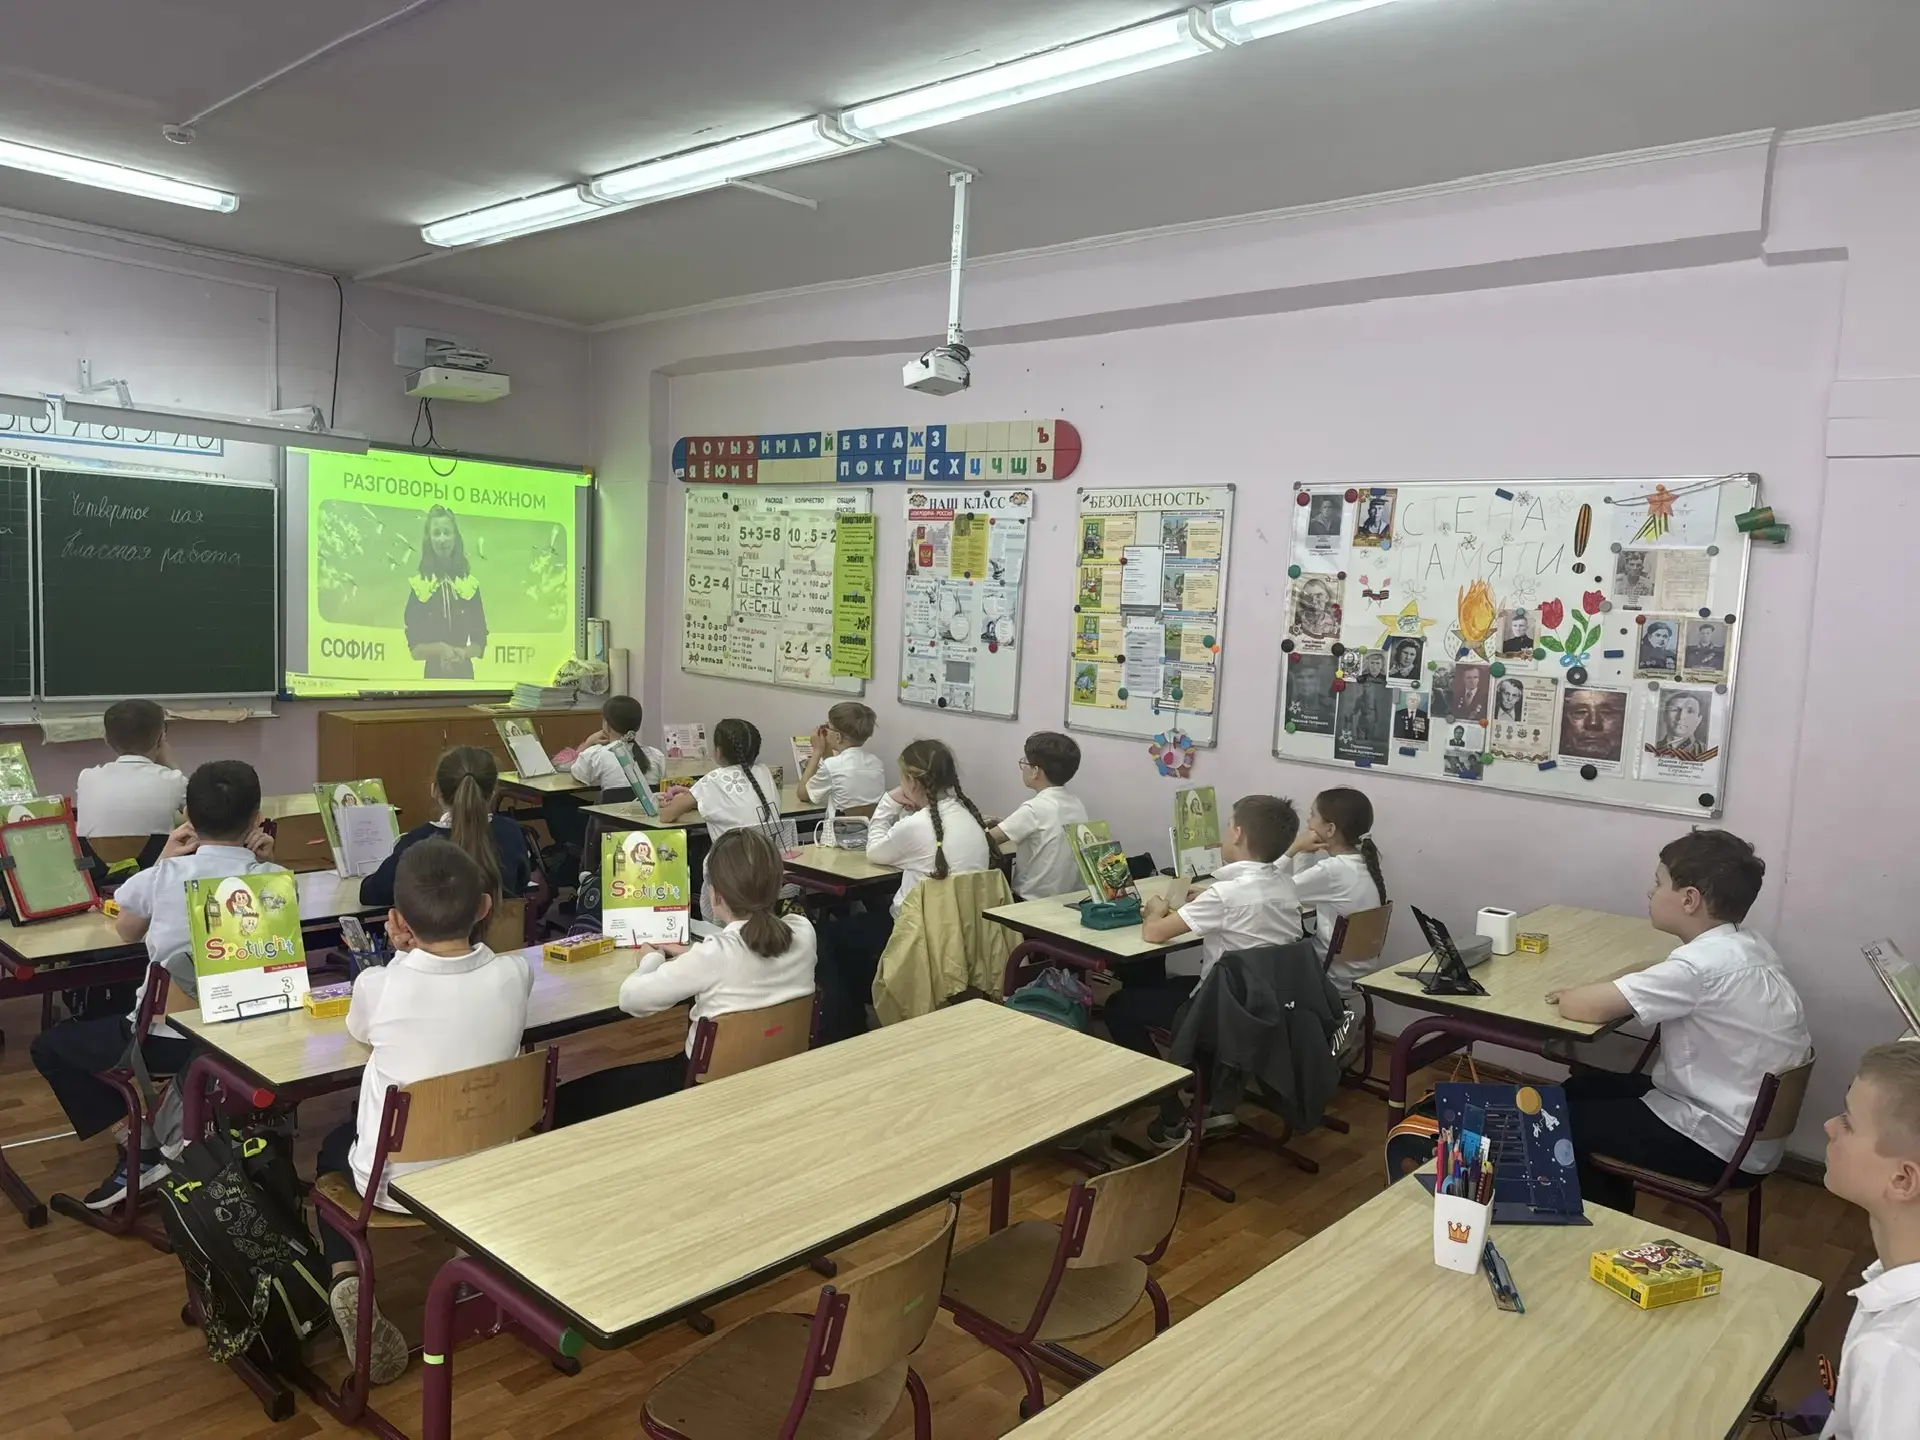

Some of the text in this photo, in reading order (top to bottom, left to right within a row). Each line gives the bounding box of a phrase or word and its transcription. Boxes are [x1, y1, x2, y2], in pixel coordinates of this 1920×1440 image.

[689, 427, 1049, 455] А О У Ы Э Н М Л Р Й Б В Г Д Ж З Ъ
[689, 457, 1047, 478] Я Ё Ю И Е П Ф К Т Ш С Х Ц Ч Щ Ь
[343, 472, 546, 509] РАЗГОВОРЫ О ВАЖНОМ
[837, 496, 856, 504] ОБЩИЙ
[1090, 492, 1206, 509] БЕЗОПАСНОСТЬ
[71, 492, 149, 527] Четвертое
[929, 497, 1006, 509] НАШ КЛАСС
[1403, 496, 1546, 535] СТЕНА
[739, 526, 780, 541] 5+3=8
[61, 528, 241, 572] Классная работа
[320, 637, 385, 661] СОФИЯ
[495, 646, 536, 664] ПЕТР
[700, 656, 724, 665] нельзя
[611, 880, 680, 900] Spotlight
[666, 916, 677, 931] 3
[205, 936, 294, 961] Spotlight
[281, 976, 294, 994] 3
